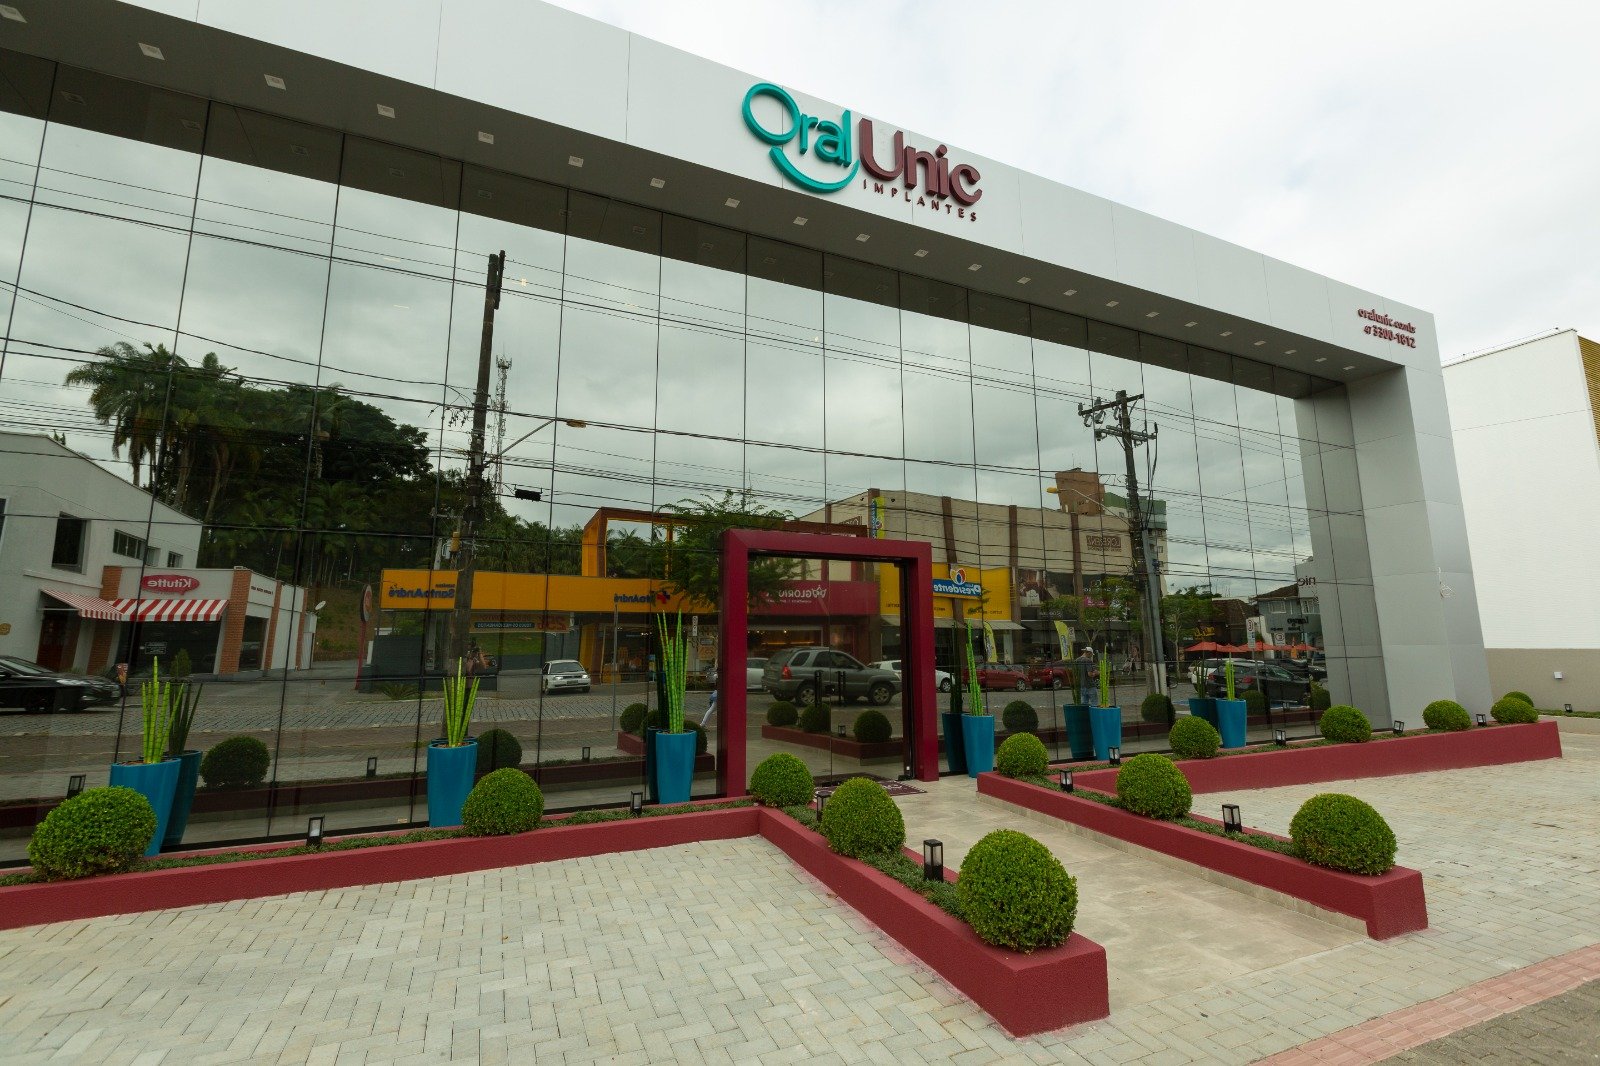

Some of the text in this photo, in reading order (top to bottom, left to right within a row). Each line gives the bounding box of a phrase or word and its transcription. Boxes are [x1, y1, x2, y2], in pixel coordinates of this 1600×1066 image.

[742, 83, 982, 206] Oral Unic
[863, 178, 977, 222] IMPLANTES
